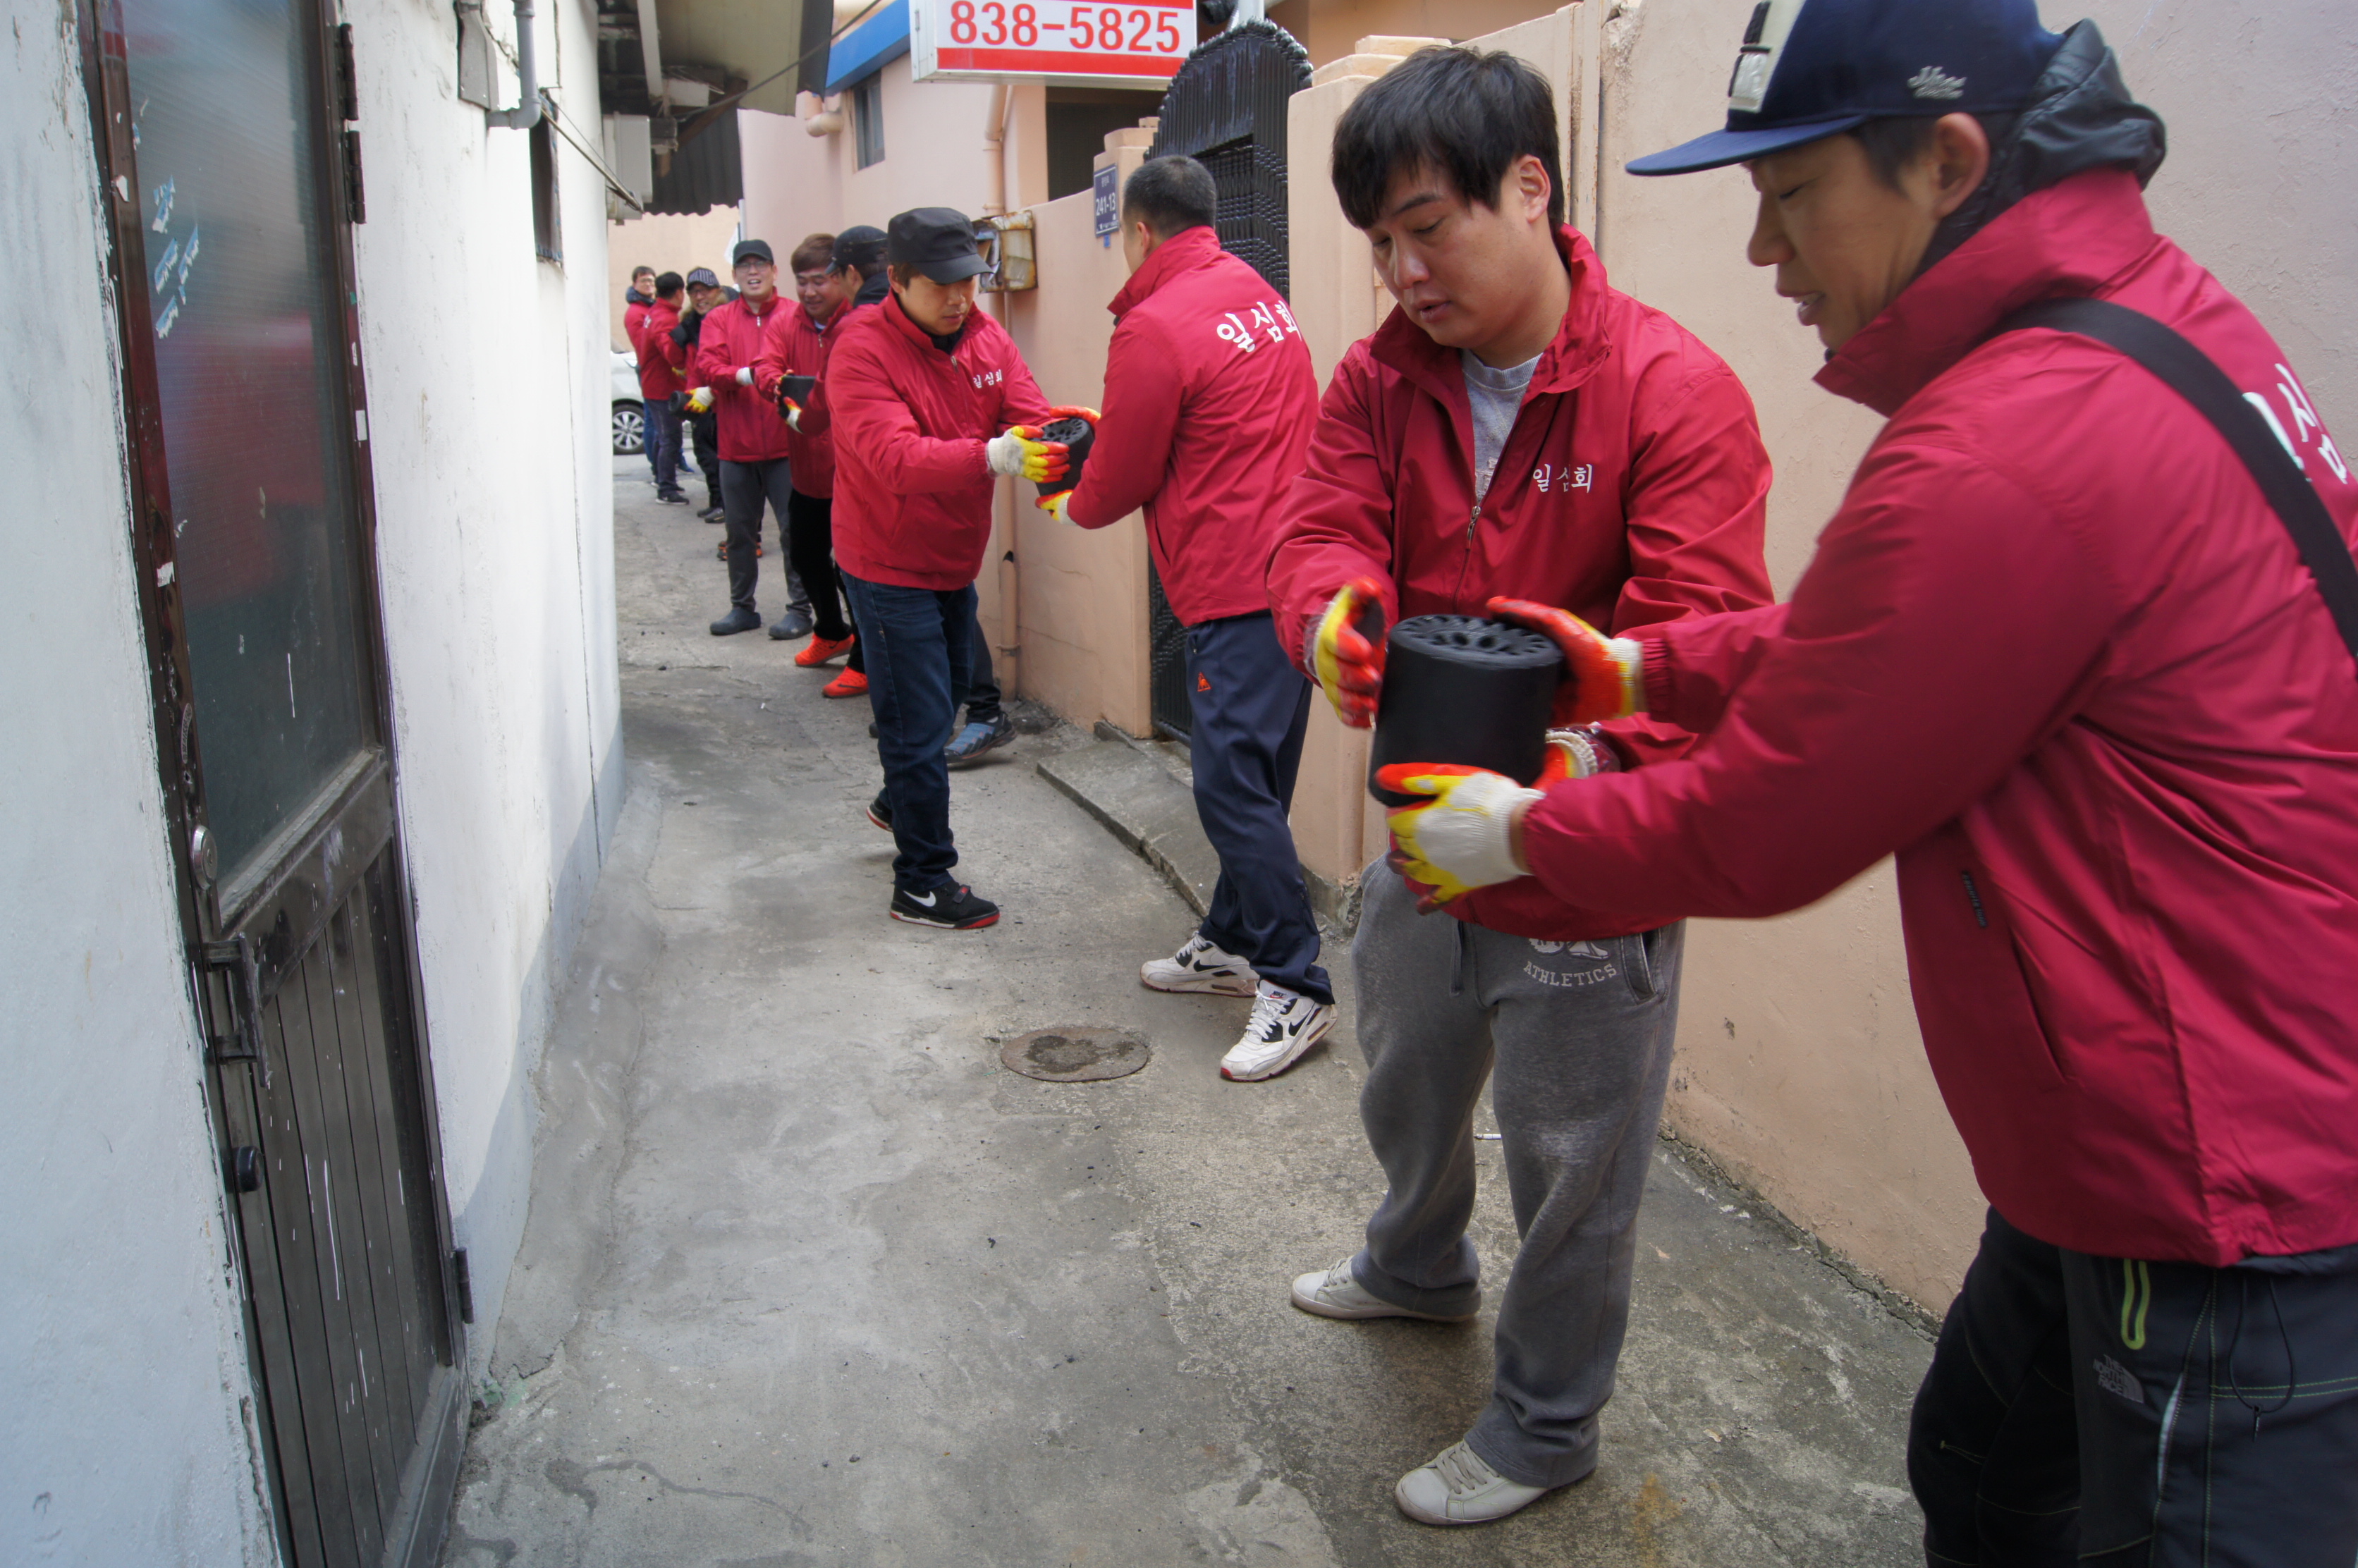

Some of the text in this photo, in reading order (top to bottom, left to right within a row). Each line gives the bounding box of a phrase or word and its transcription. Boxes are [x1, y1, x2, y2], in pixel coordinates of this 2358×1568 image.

[950, 0, 1180, 53] 838-5825
[1096, 192, 1116, 216] 241-13
[1216, 300, 1302, 353] 일심회
[1523, 960, 1617, 987] ATHLETICS
